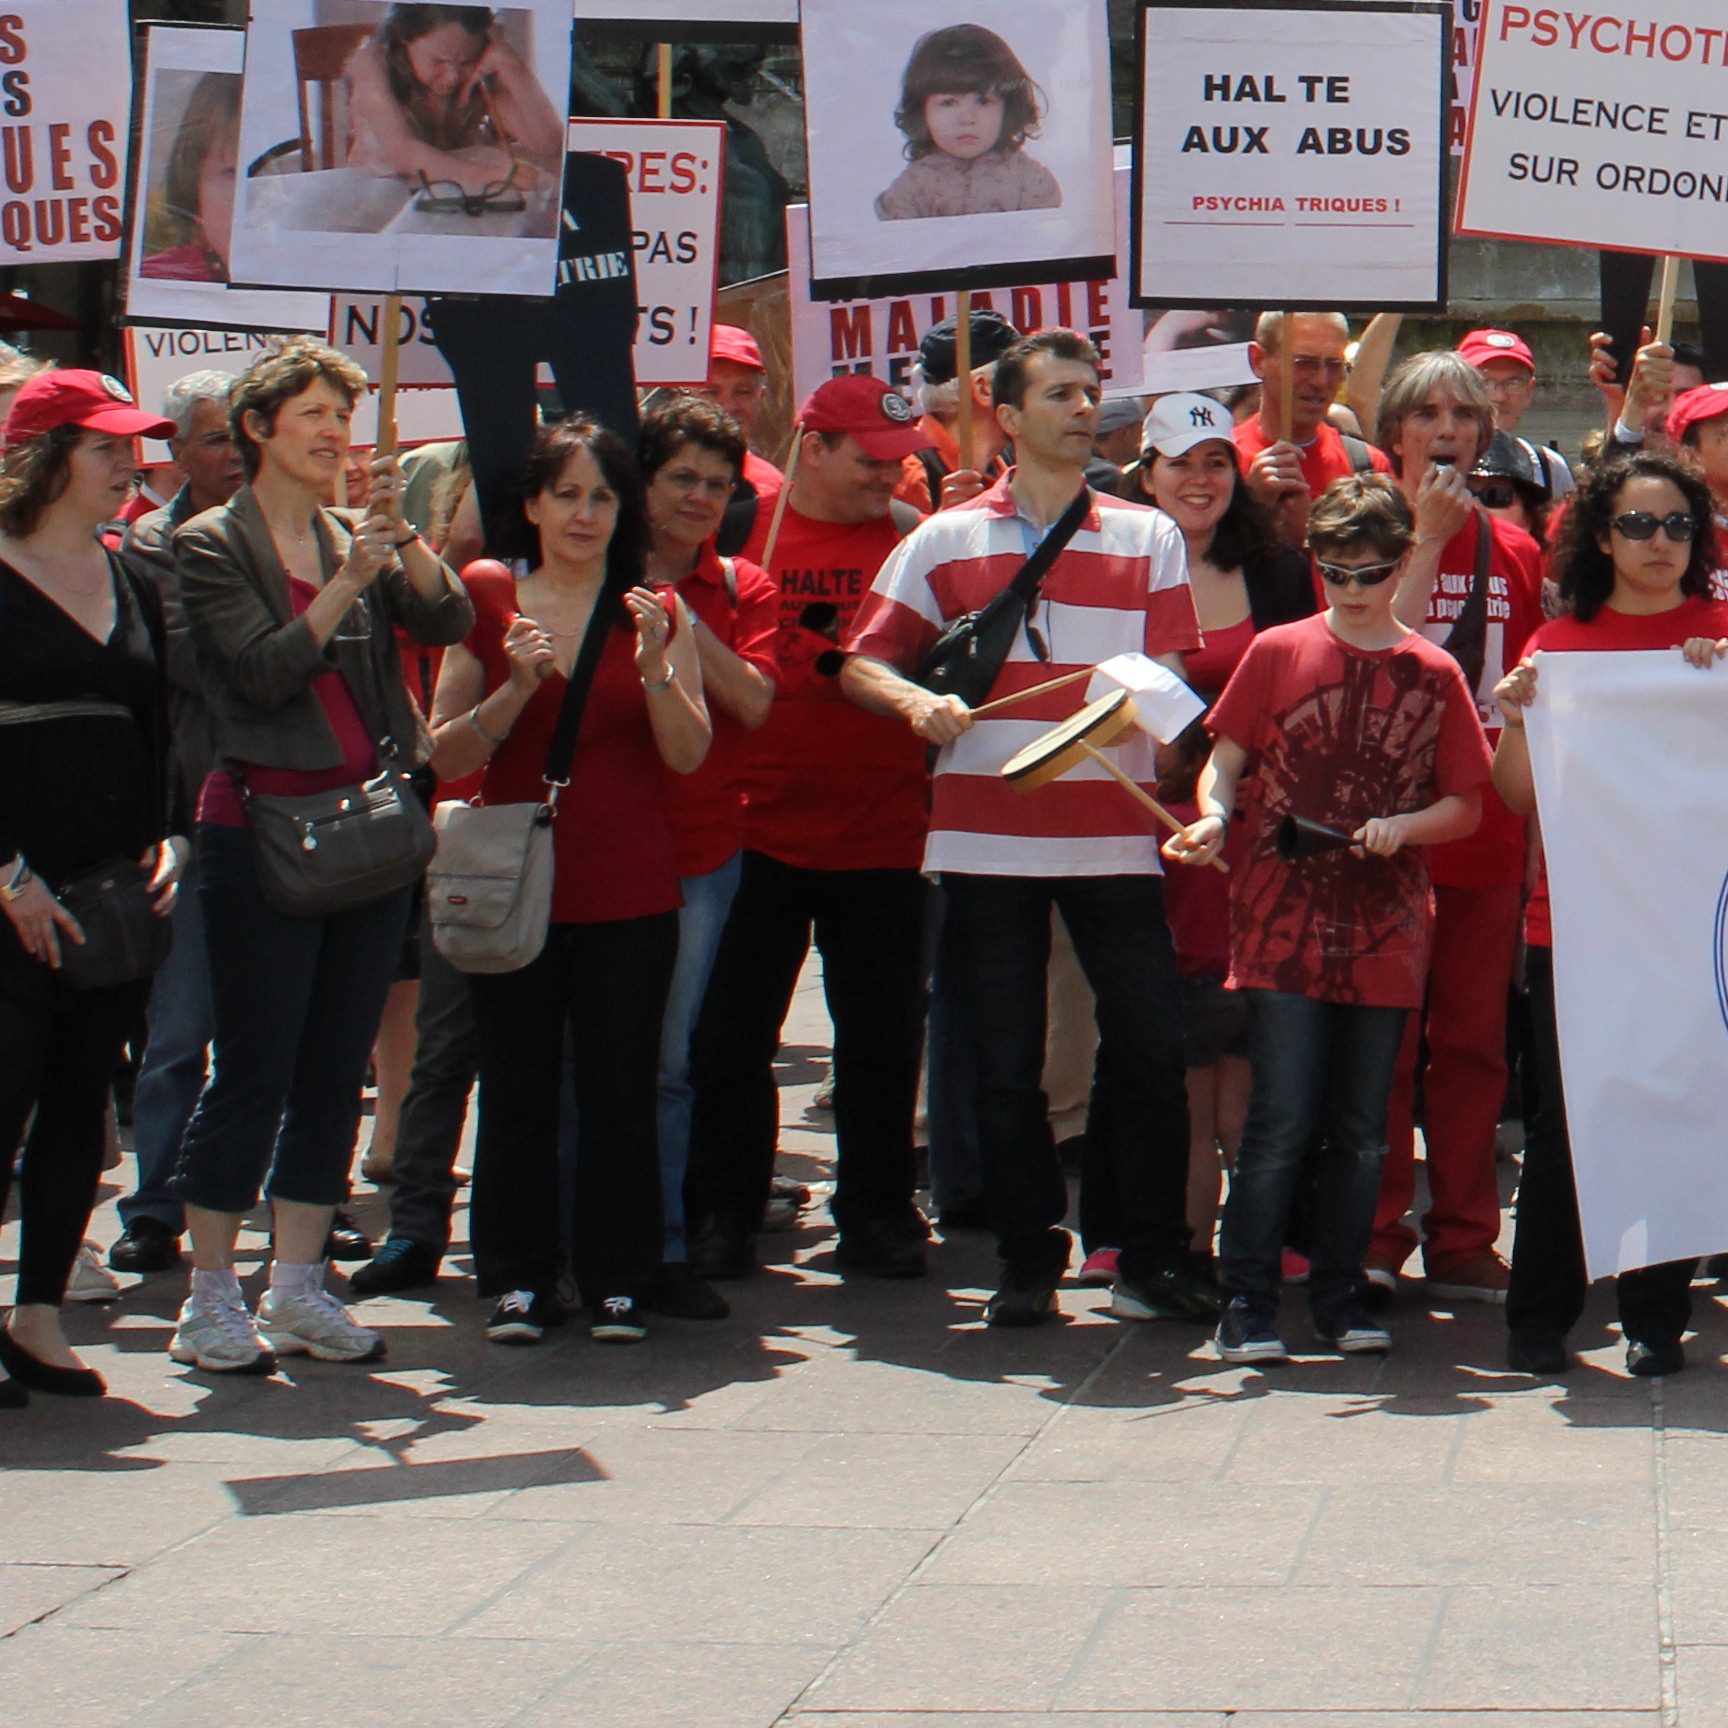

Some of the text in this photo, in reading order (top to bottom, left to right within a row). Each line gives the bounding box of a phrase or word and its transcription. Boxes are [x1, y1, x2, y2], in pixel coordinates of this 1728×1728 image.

[1489, 88, 1671, 136] VIOLENCE
[1181, 126, 1411, 156] AUX ABUS
[1508, 152, 1580, 186] SUR
[781, 569, 863, 596] HALTE
